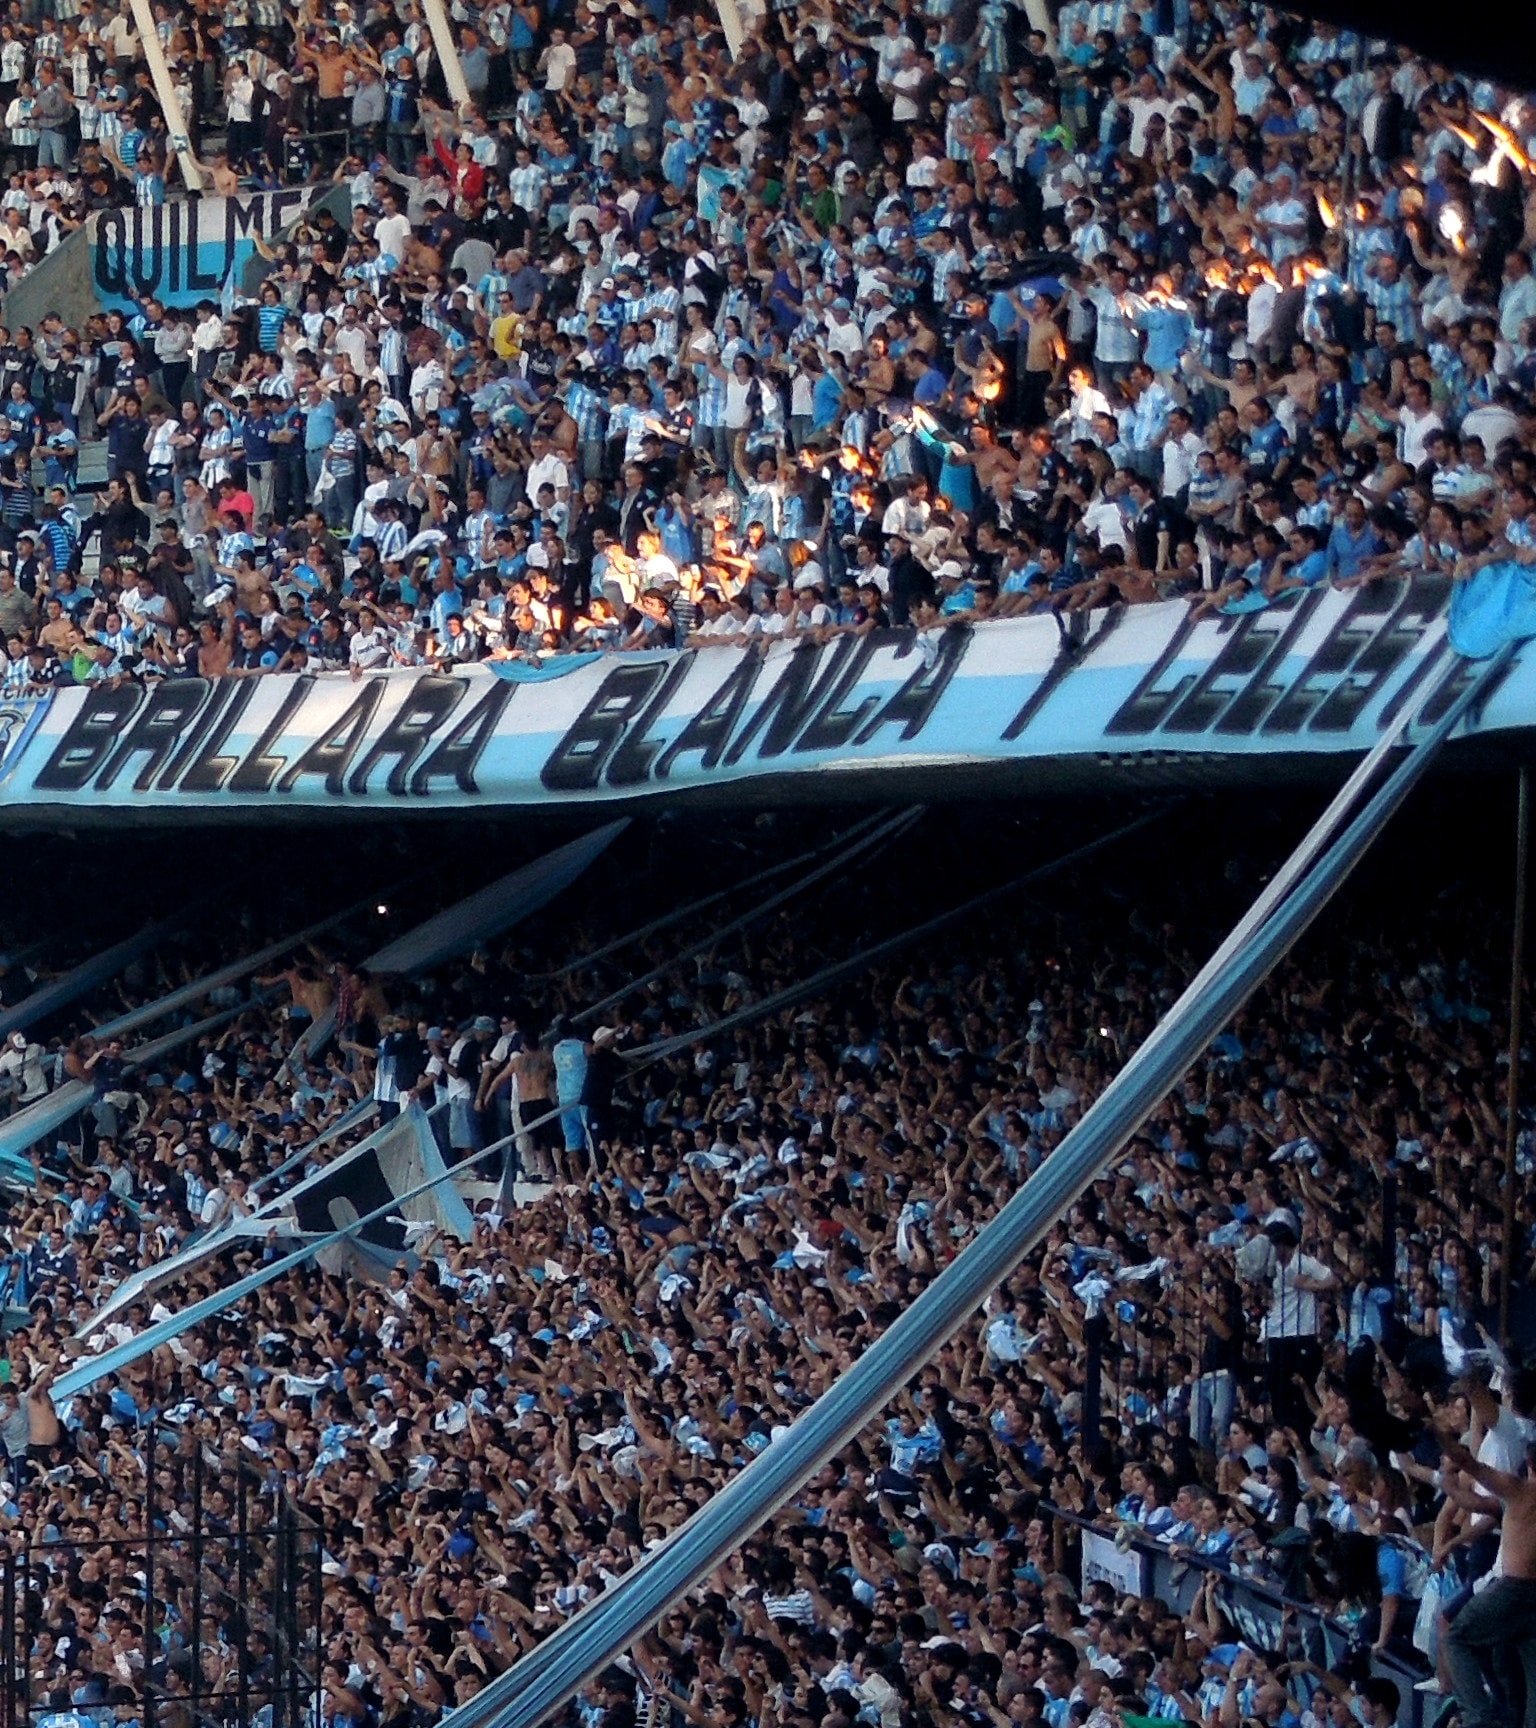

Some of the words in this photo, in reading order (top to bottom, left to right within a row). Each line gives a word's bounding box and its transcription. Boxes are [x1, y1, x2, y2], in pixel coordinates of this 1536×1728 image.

[32, 674, 516, 796] BRILLARA
[540, 627, 975, 791] BLANCA
[1000, 603, 1125, 741] Y
